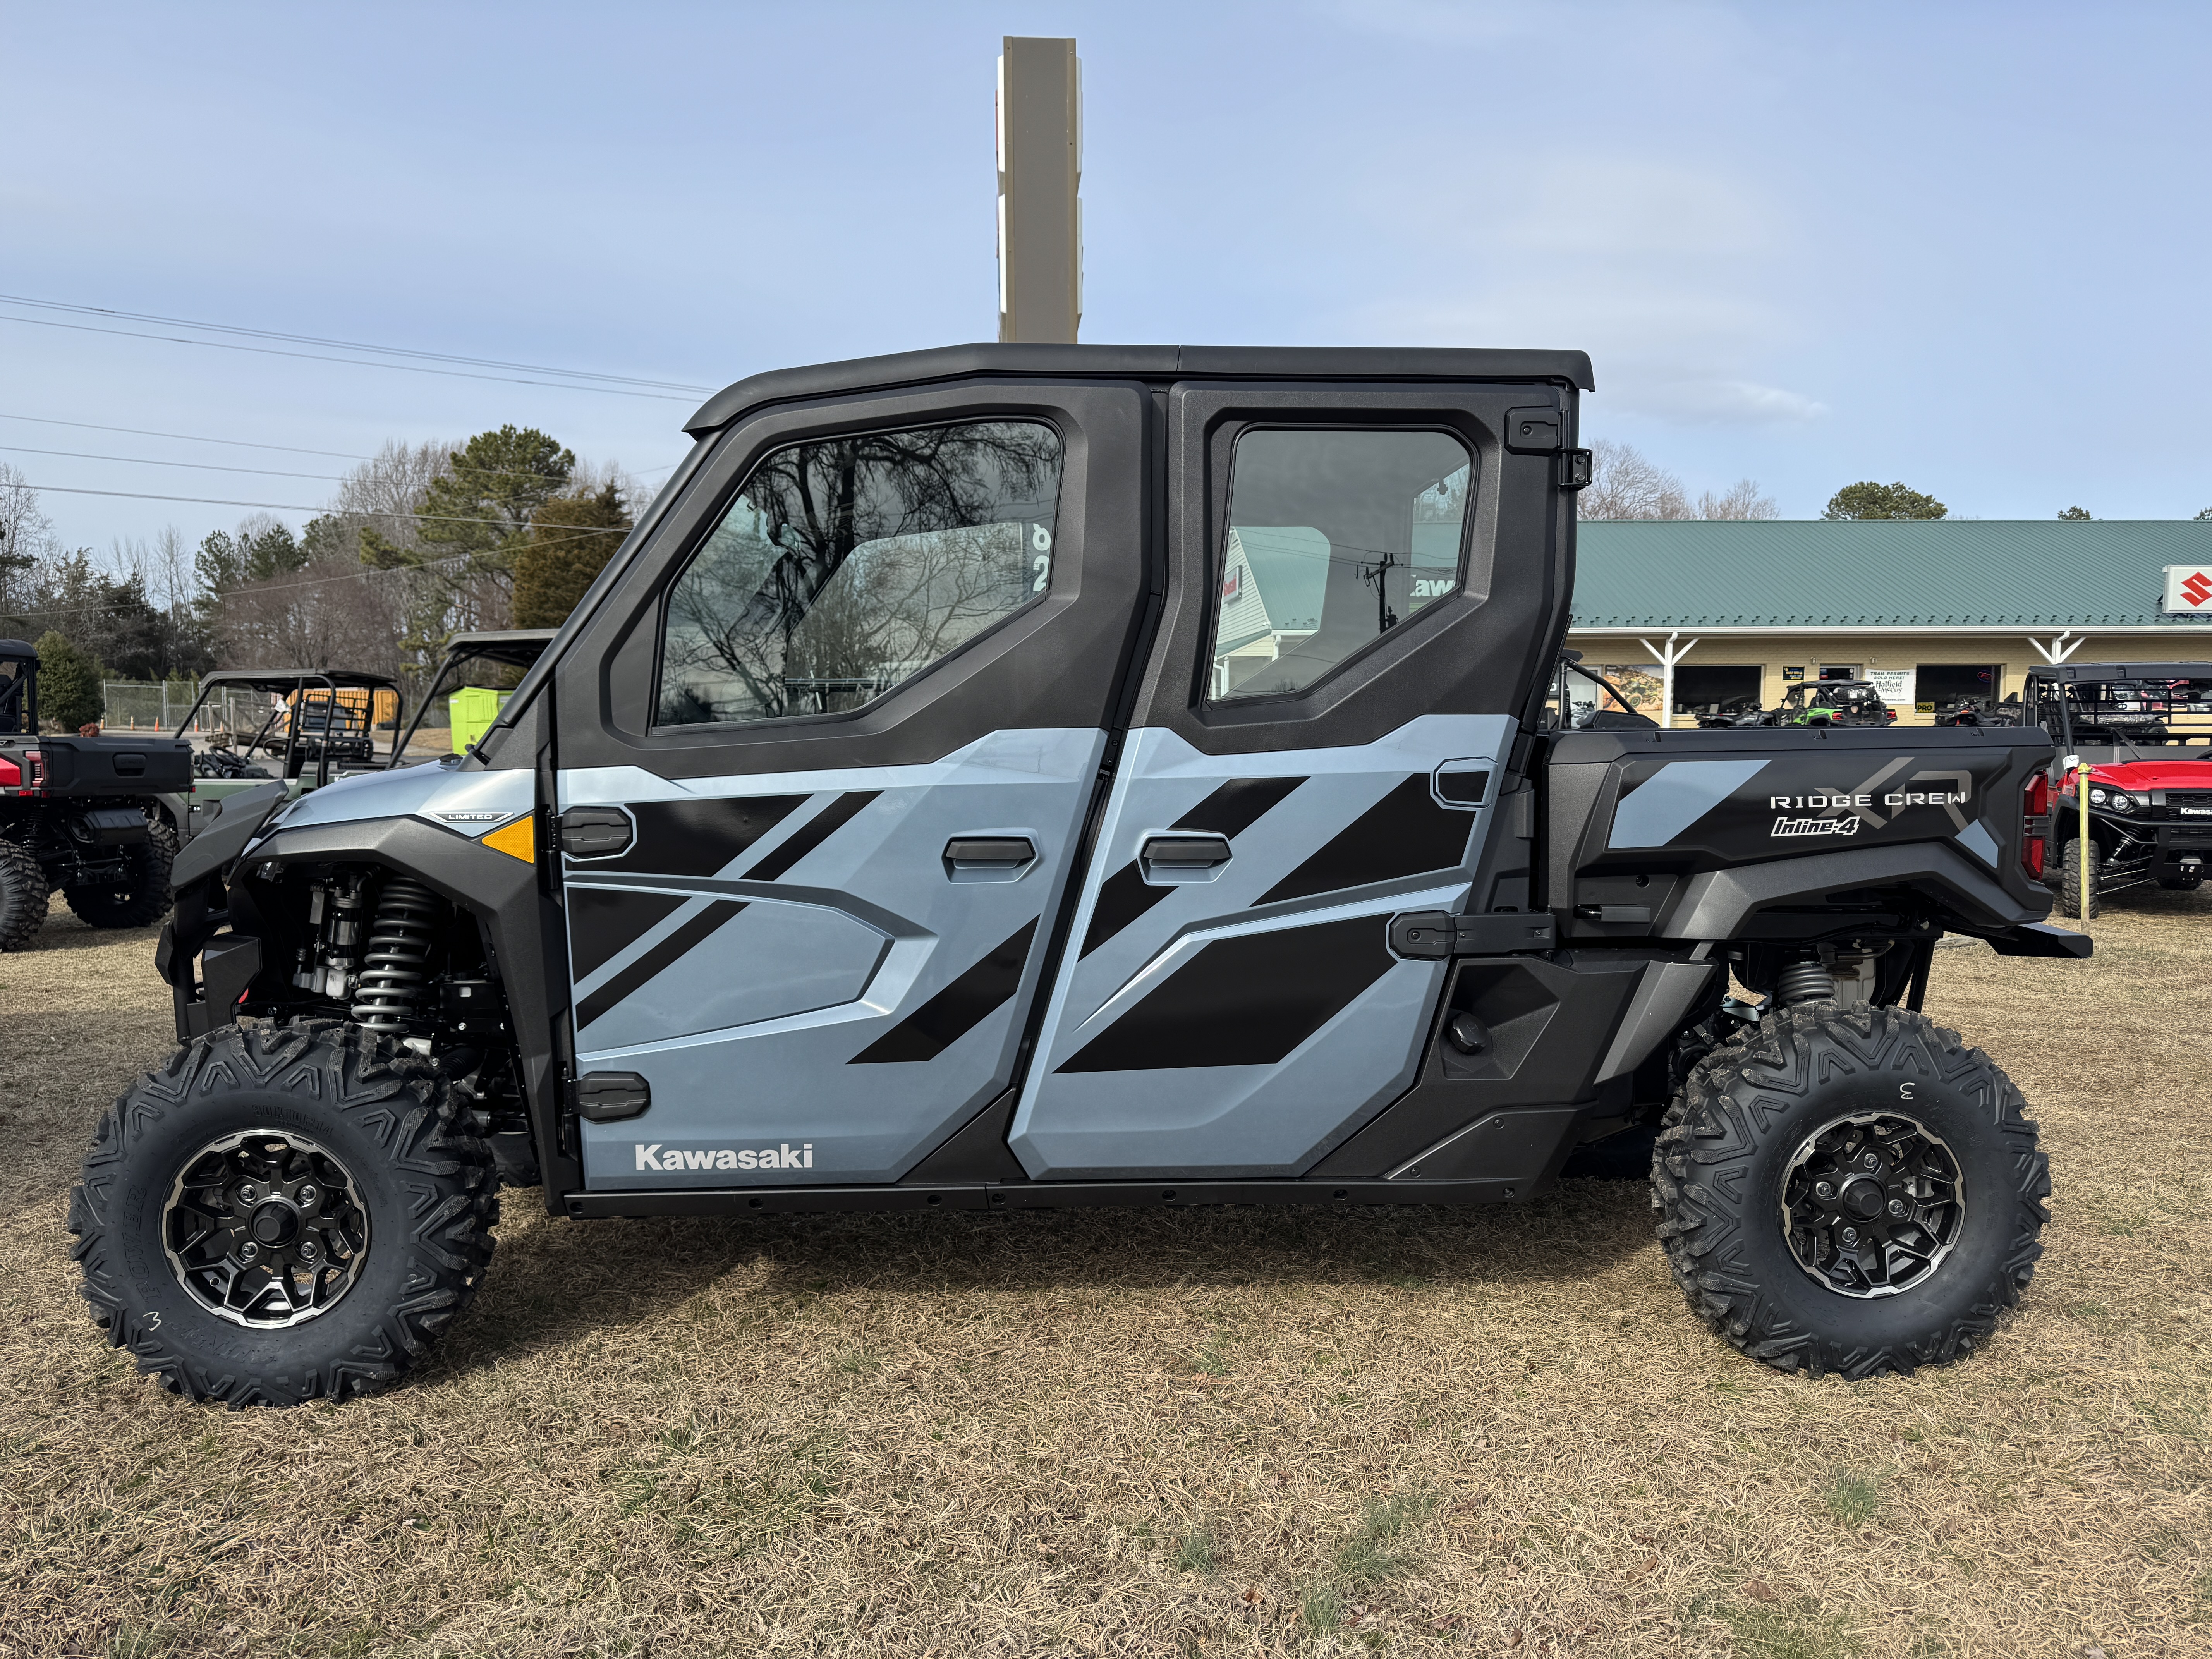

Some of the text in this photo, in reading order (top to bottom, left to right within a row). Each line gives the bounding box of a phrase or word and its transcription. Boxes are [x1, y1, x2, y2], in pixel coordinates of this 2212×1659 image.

[1771, 792, 1966, 809] RIDGE CREW
[1770, 816, 1860, 837] Inline-4
[635, 1143, 812, 1170] Kawasaki
[143, 1312, 161, 1331] 3
